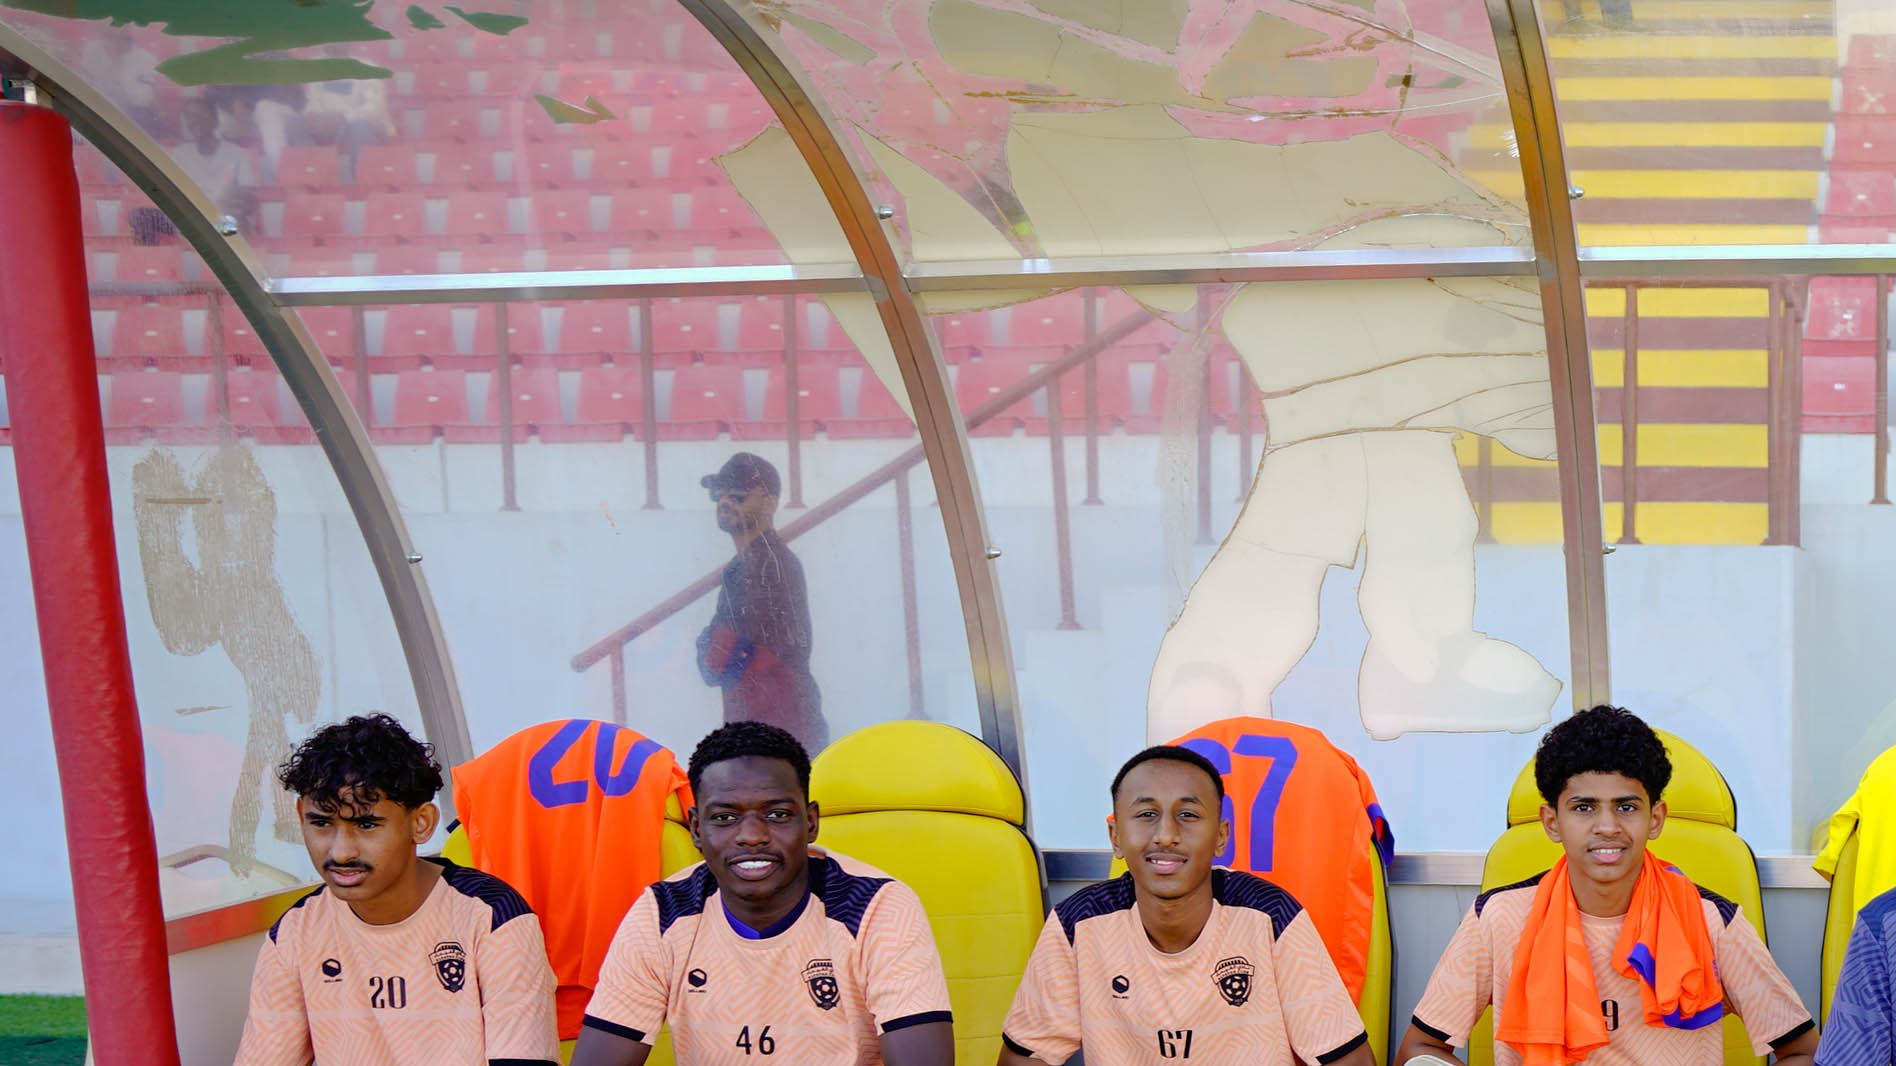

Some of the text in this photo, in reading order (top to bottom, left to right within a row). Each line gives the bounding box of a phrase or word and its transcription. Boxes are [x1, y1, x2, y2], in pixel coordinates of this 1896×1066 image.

[369, 975, 407, 1009] 20
[735, 1025, 776, 1055] 46
[1157, 1029, 1193, 1059] 67
